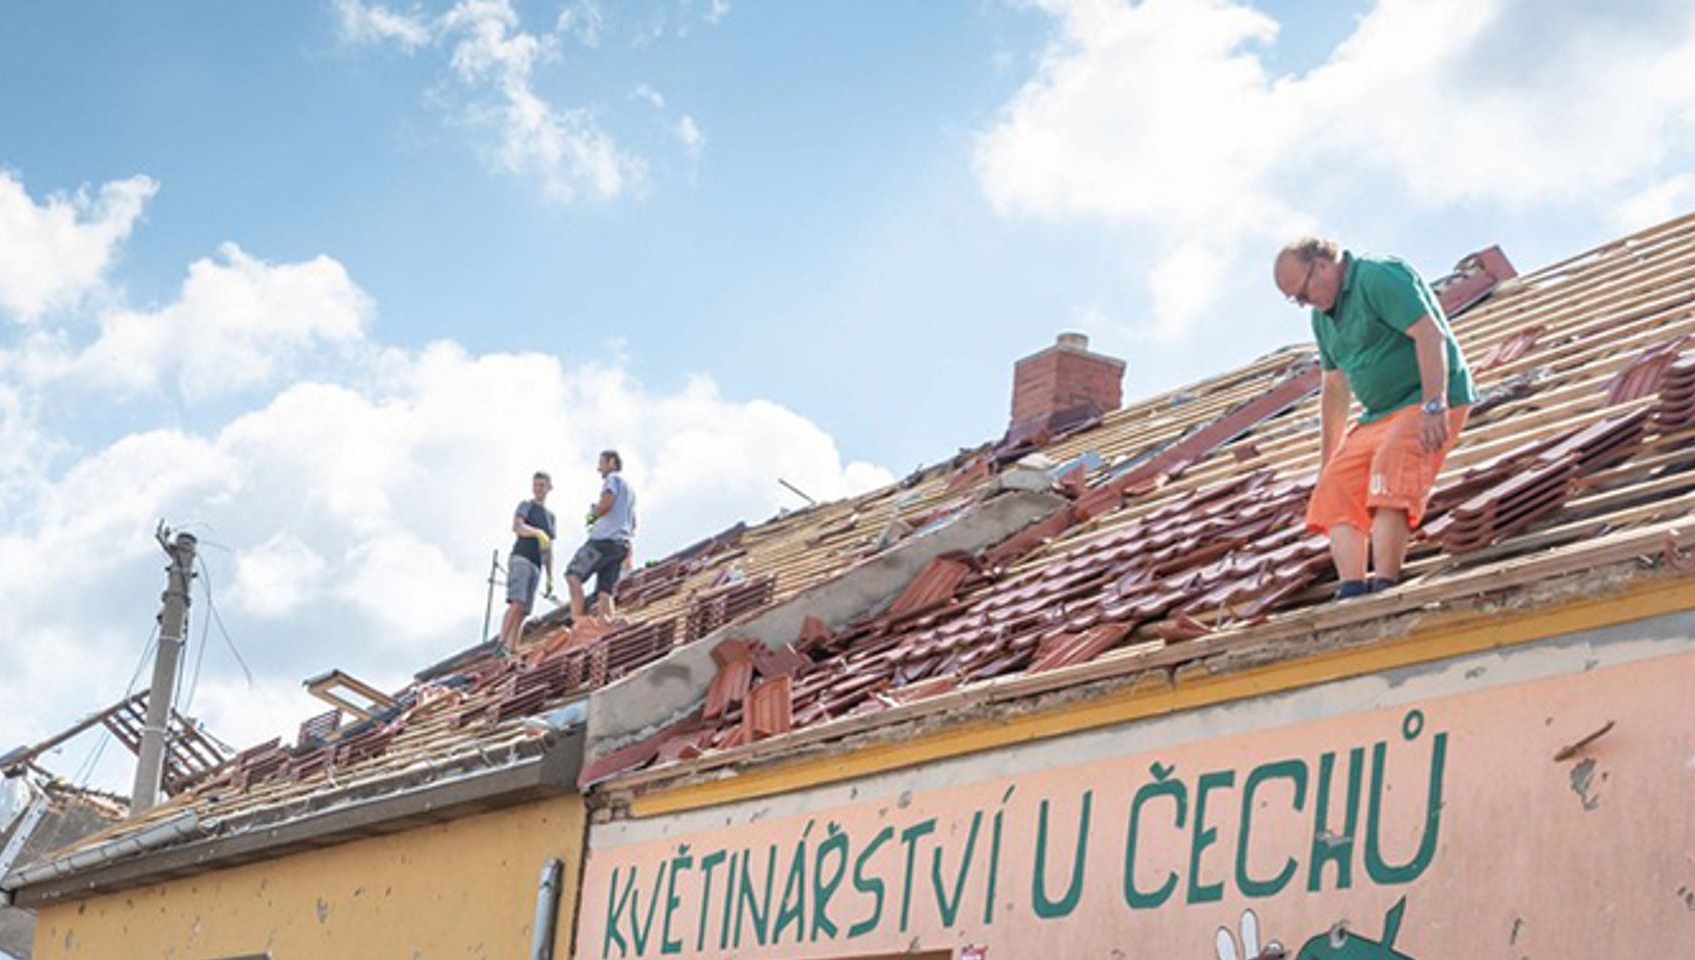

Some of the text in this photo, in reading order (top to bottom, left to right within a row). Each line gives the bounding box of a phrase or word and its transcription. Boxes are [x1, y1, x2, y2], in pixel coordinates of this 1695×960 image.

[603, 709, 1449, 960] KVĚTINÁŘSTVÍ U ČECHŮ
